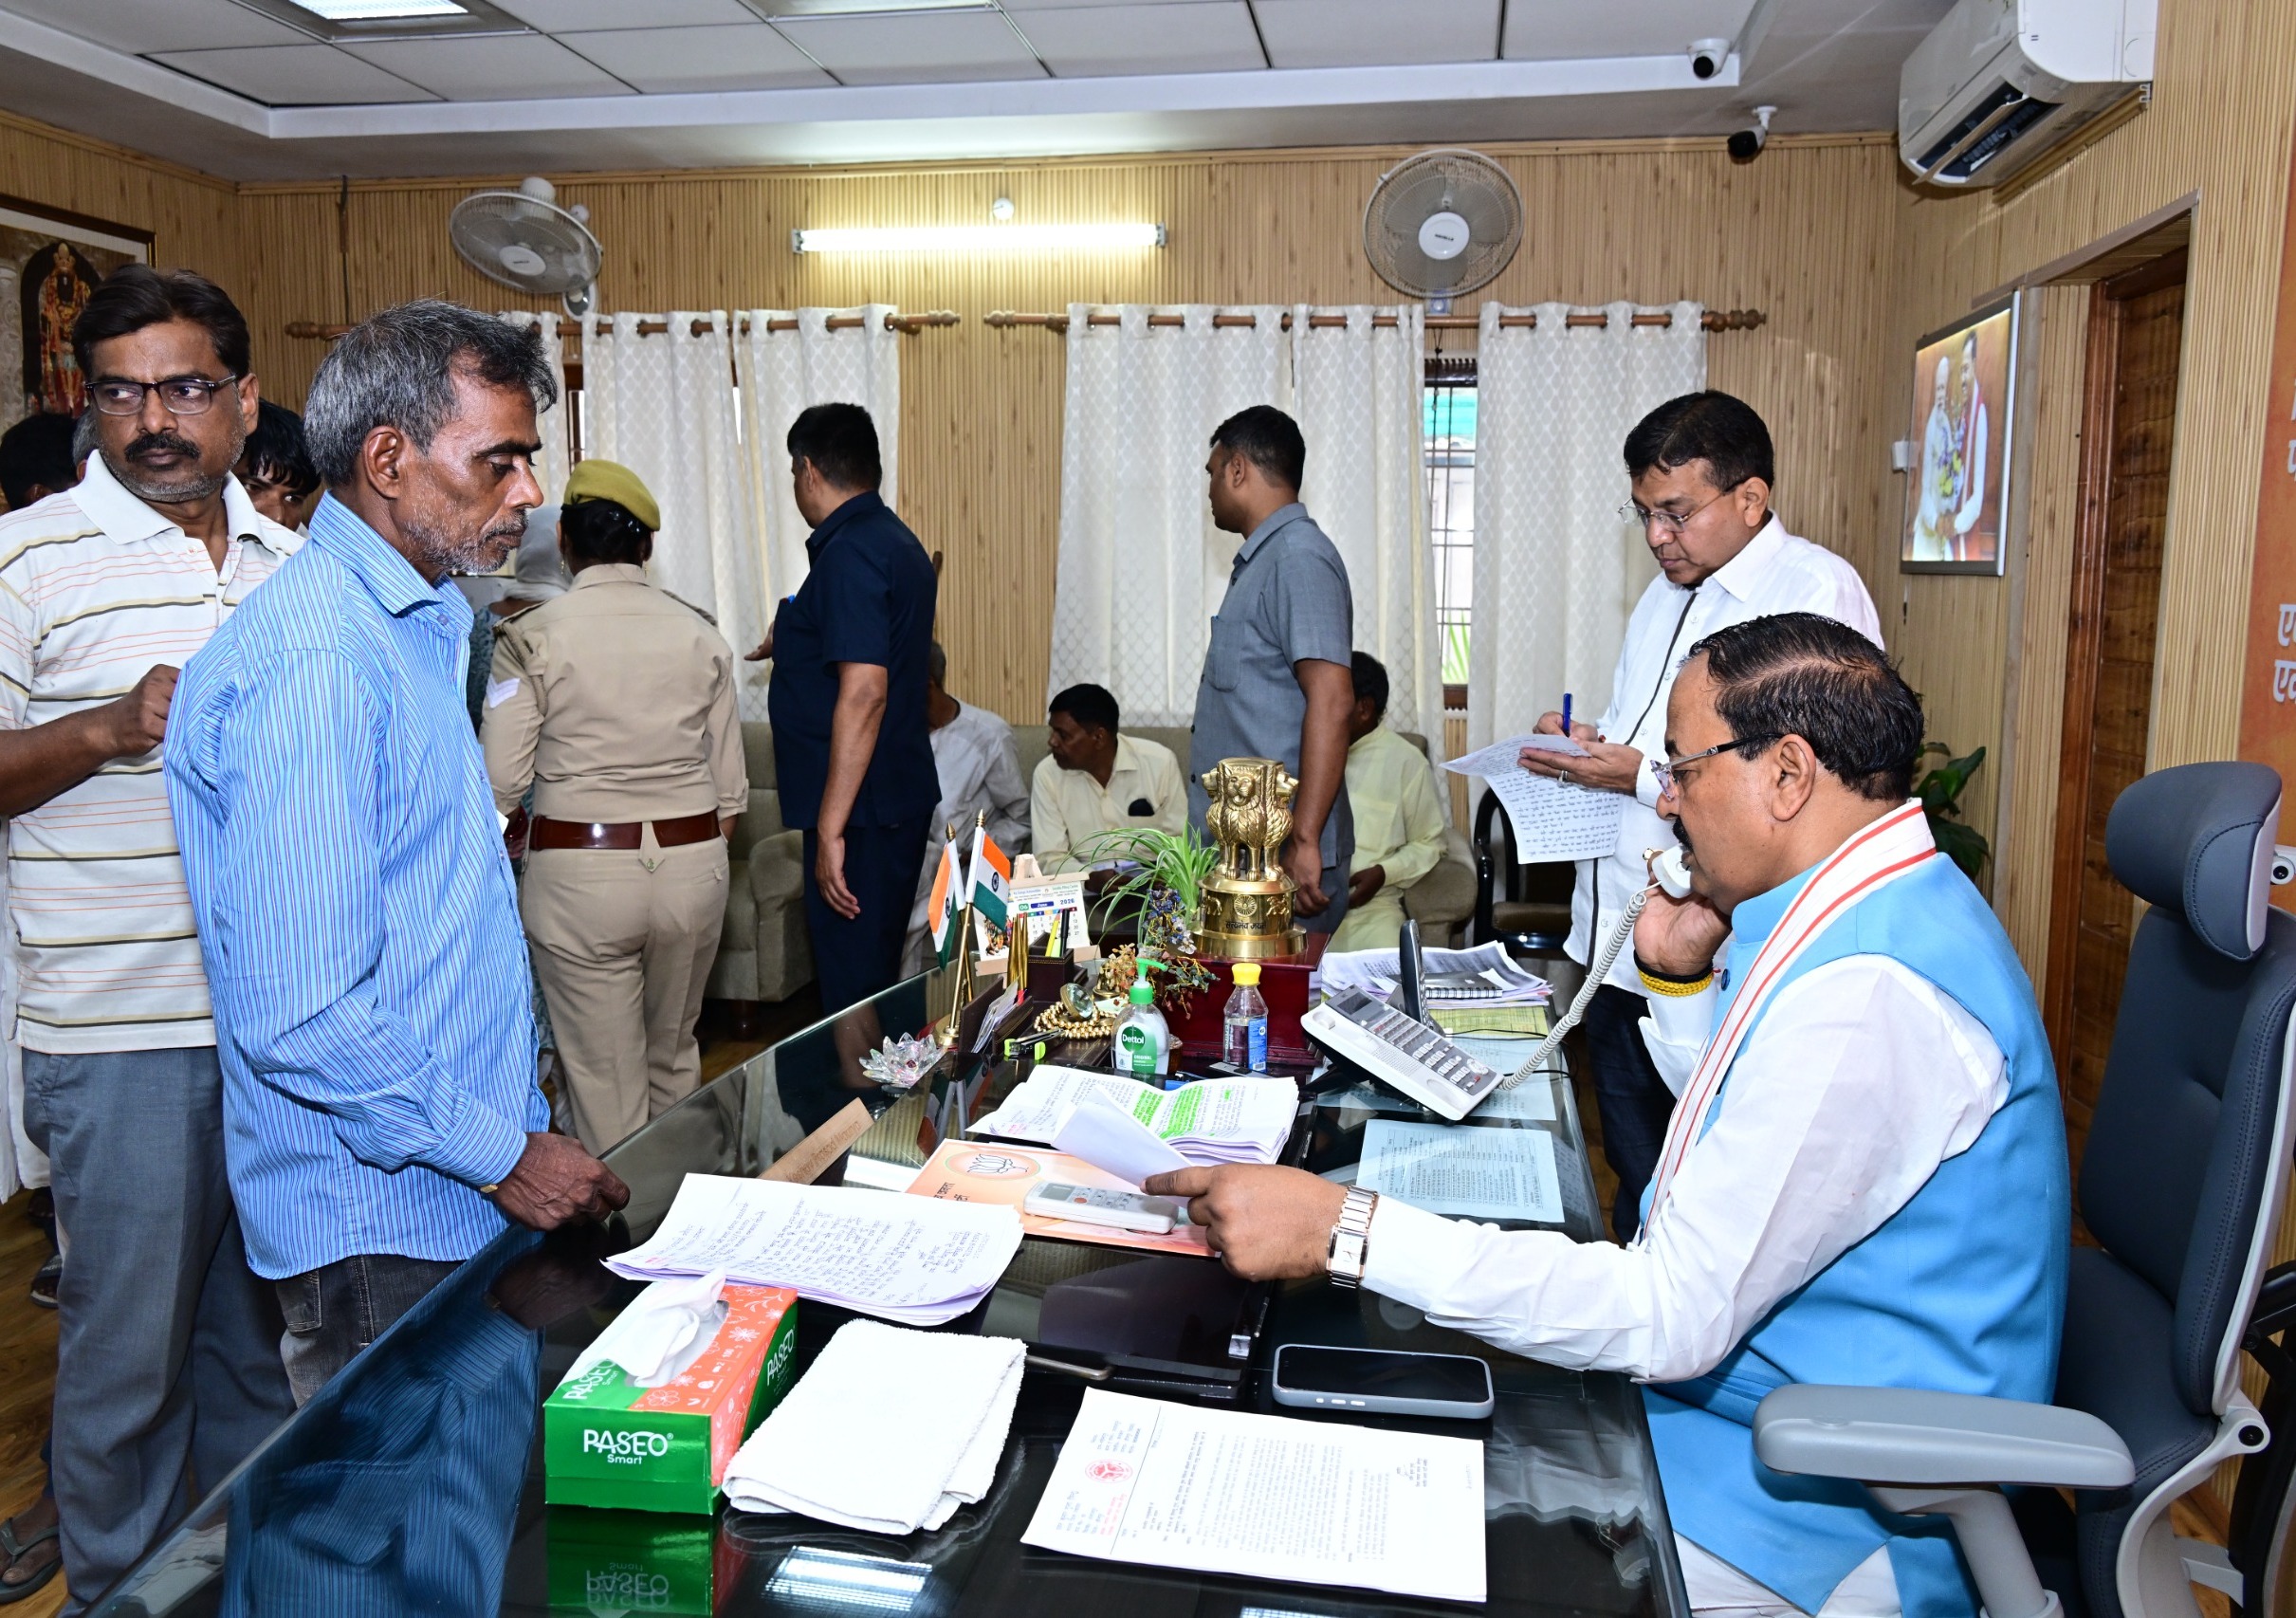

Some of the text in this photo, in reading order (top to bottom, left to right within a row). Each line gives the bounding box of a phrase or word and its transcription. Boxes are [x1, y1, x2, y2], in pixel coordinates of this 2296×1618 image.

[1122, 1034, 1145, 1044] Dettol
[767, 1329, 794, 1387] PASEO
[583, 1429, 669, 1457] PASEO
[607, 1454, 642, 1464] Smart
